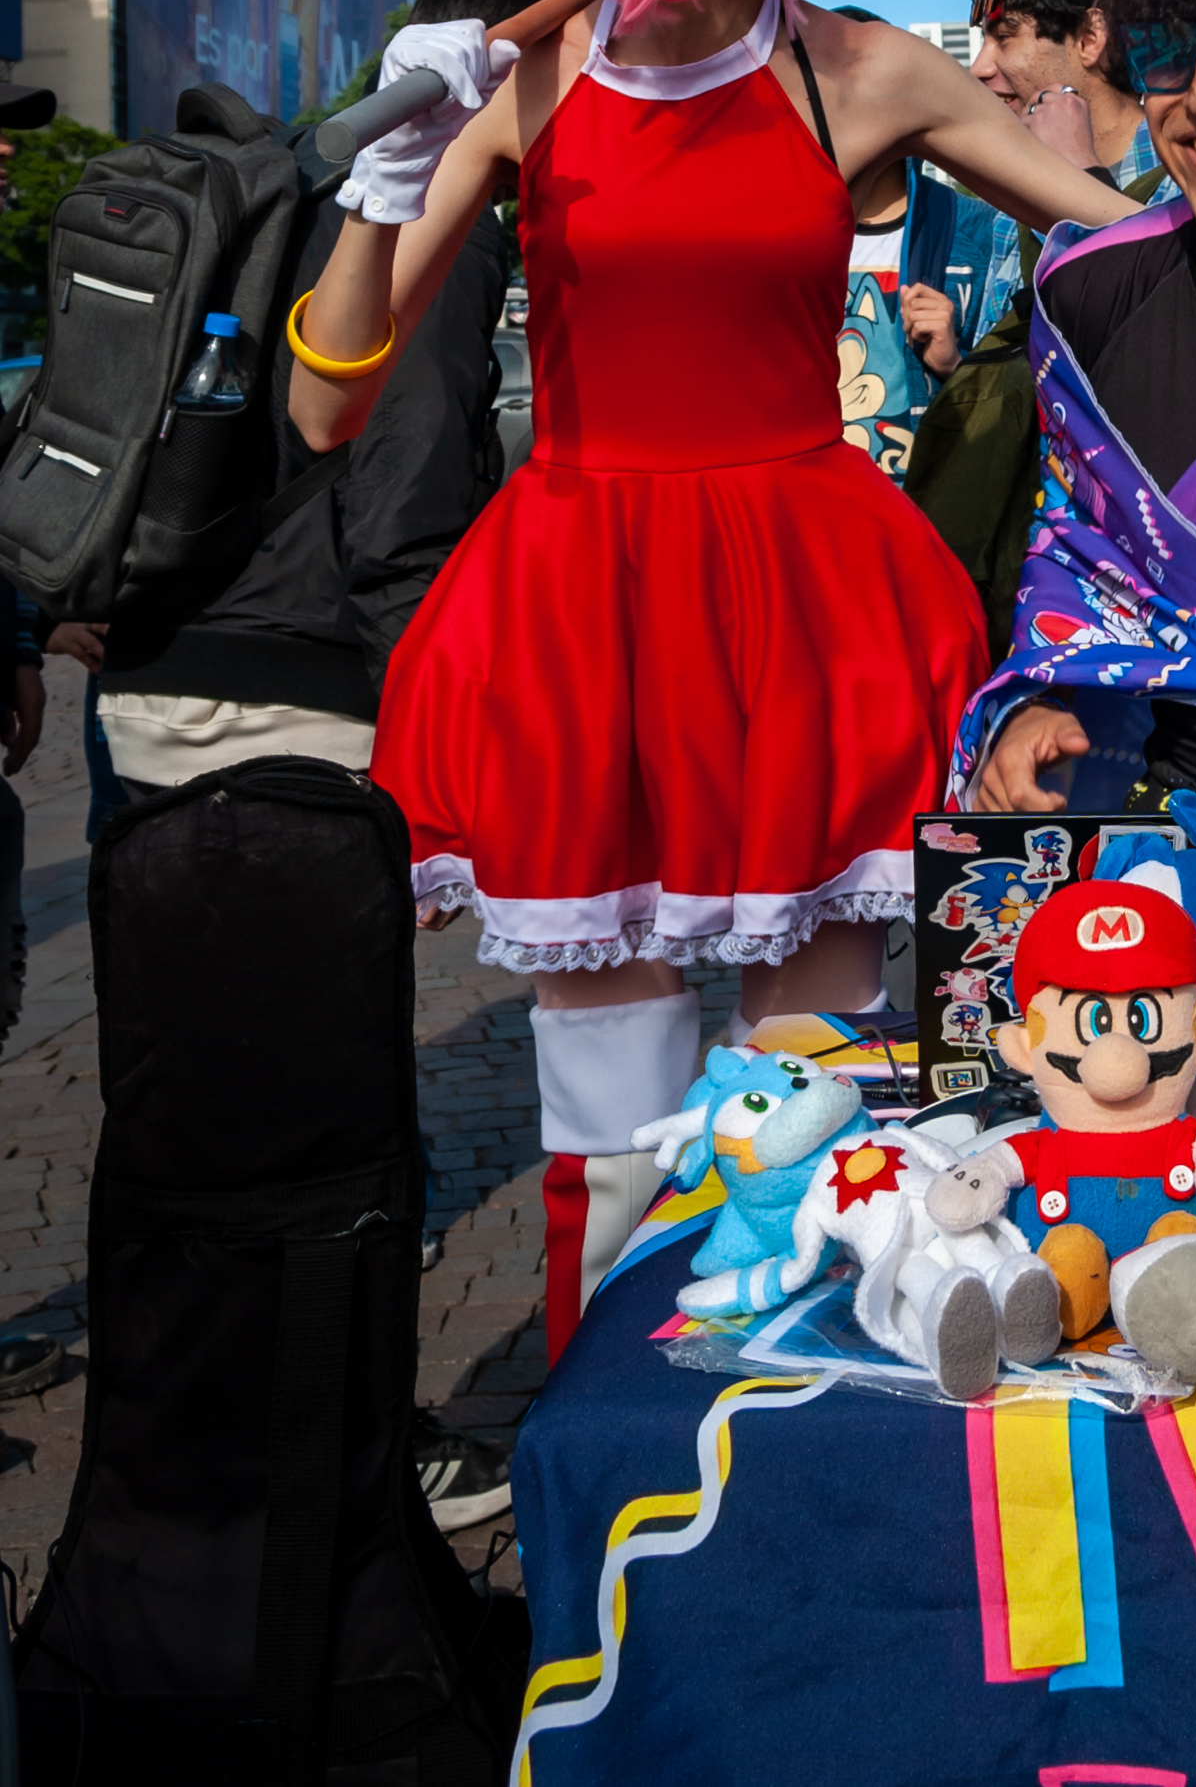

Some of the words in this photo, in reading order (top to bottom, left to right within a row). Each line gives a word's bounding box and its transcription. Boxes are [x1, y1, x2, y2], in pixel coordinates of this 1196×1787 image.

[195, 13, 223, 68] Es
[226, 31, 269, 88] por
[1091, 911, 1132, 944] M
